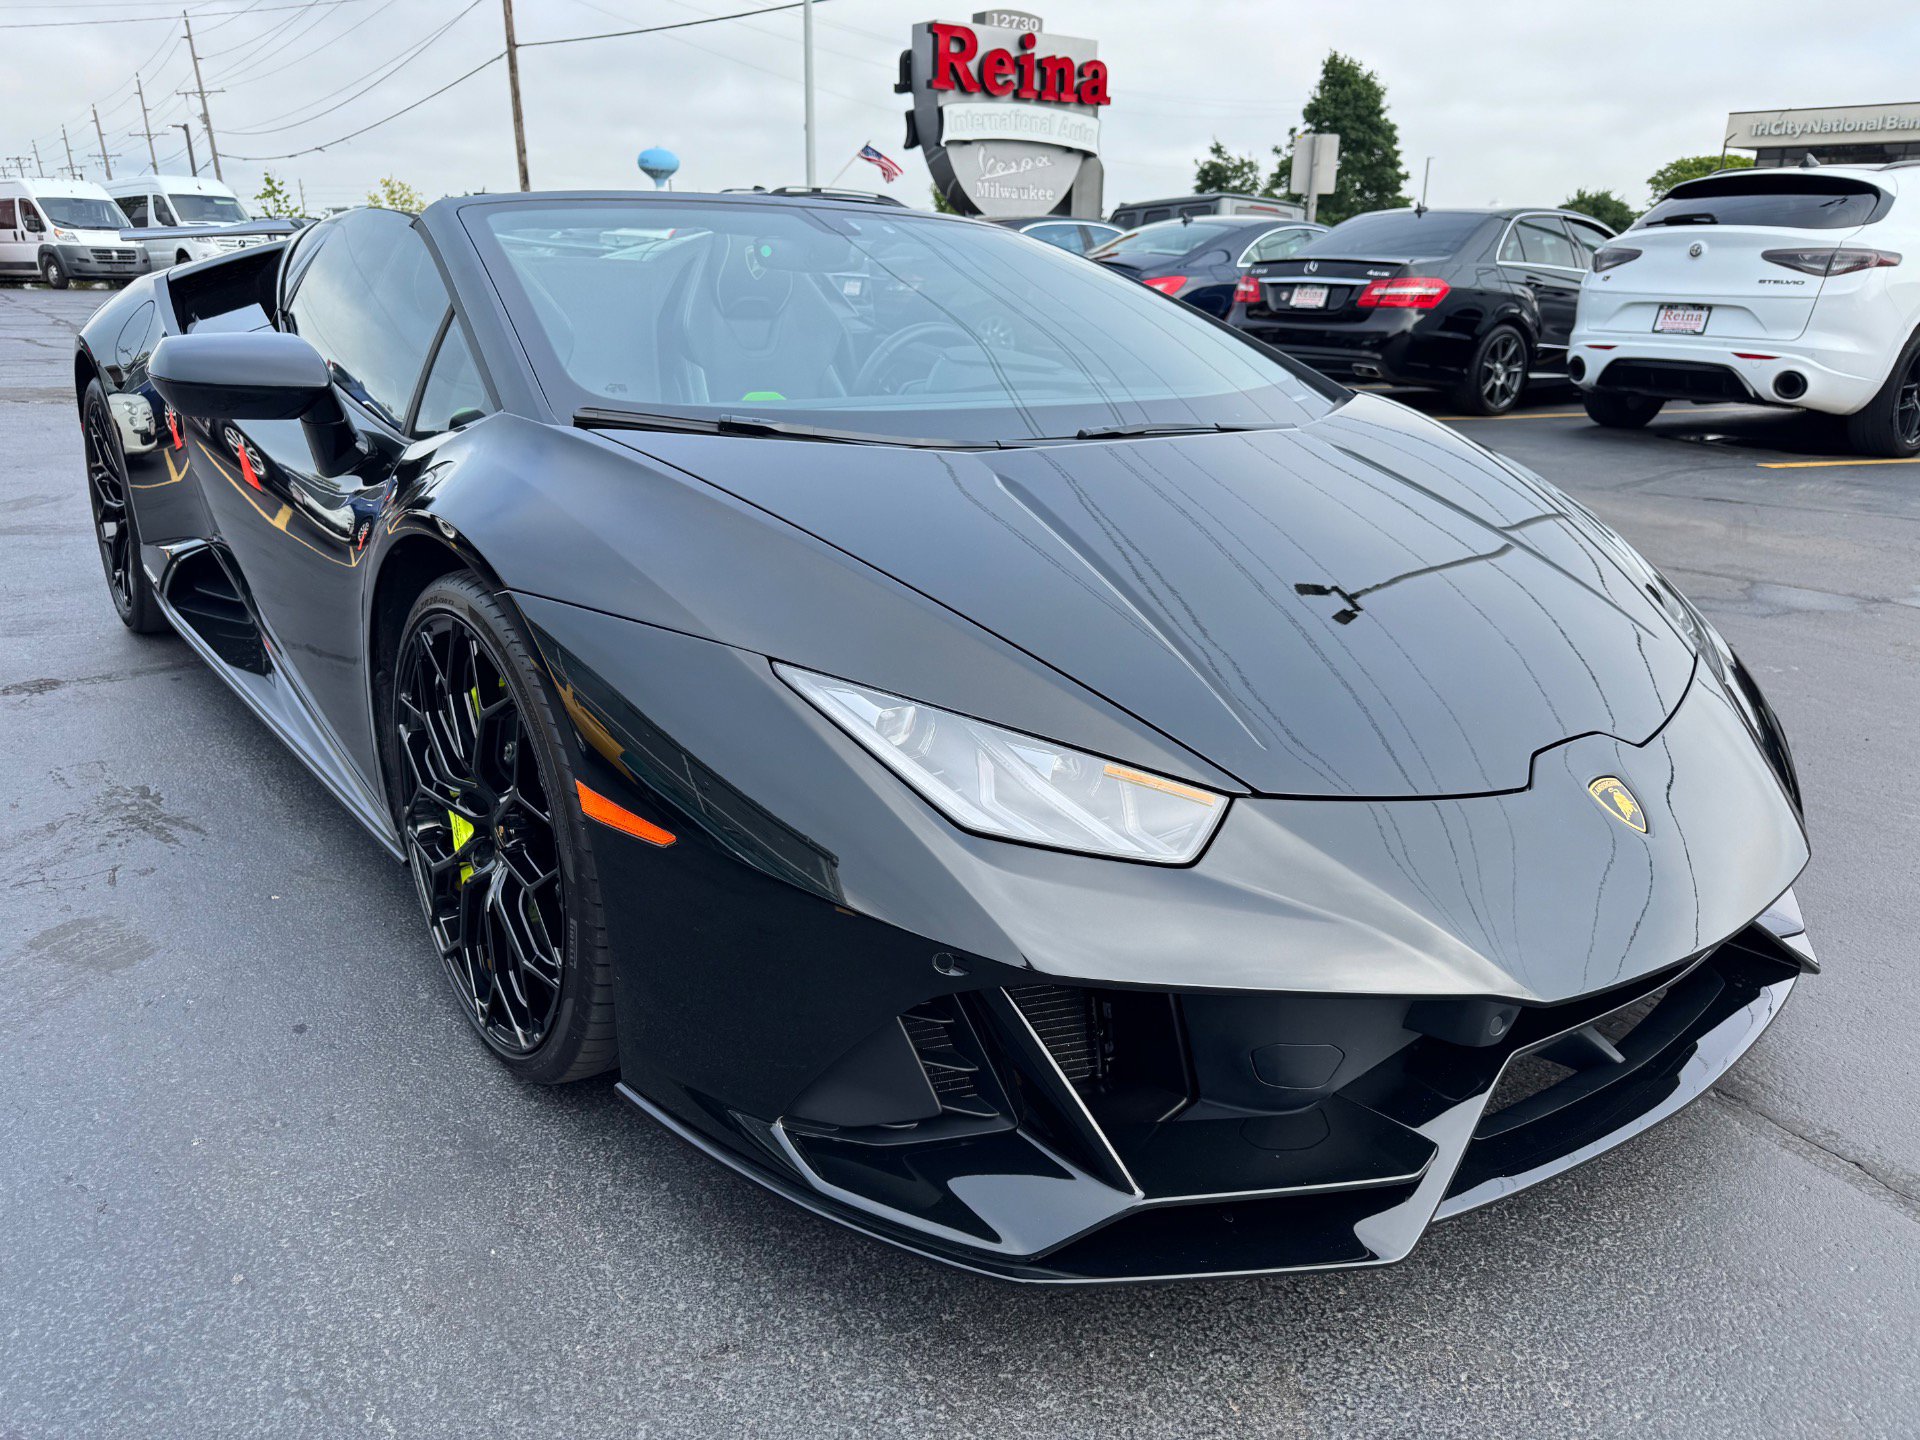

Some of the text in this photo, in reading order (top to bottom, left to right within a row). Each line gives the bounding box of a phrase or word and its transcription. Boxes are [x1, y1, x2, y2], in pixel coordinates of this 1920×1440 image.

[991, 13, 1039, 32] 12730
[928, 23, 1111, 106] Reina
[949, 108, 1053, 138] International
[1807, 116, 1882, 134] National
[978, 144, 1053, 180] Vespa
[975, 181, 1055, 201] Milwaukee
[1662, 309, 1703, 322] Reina
